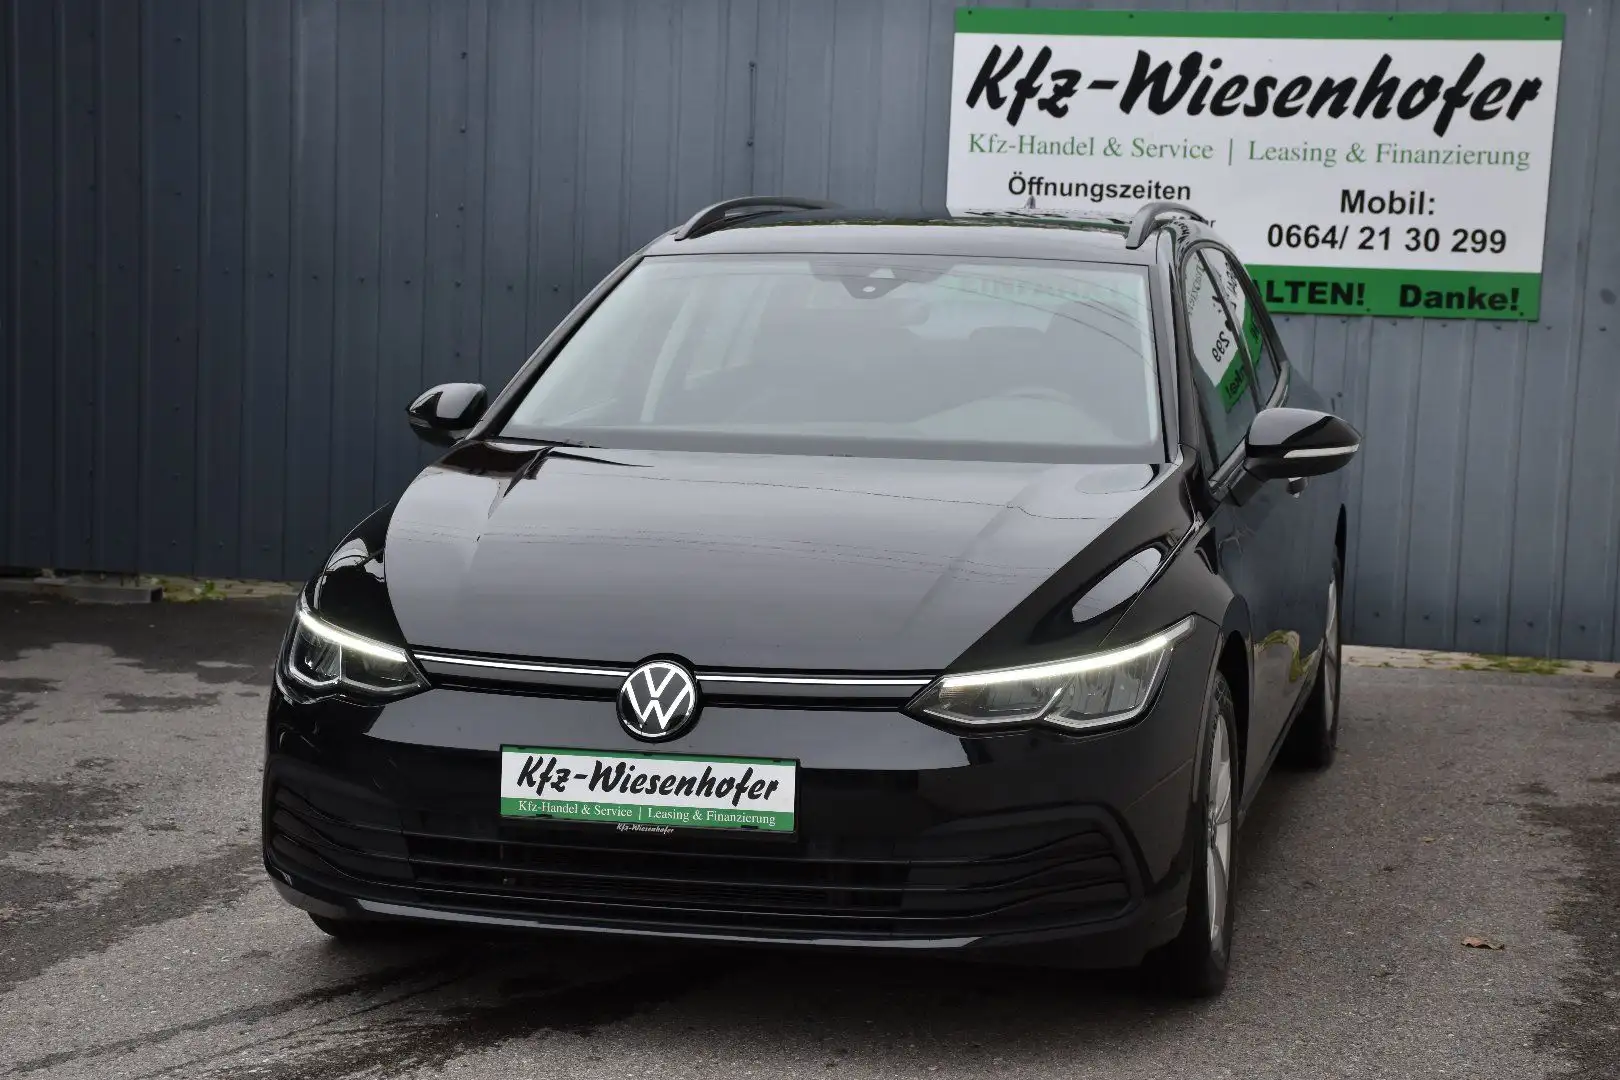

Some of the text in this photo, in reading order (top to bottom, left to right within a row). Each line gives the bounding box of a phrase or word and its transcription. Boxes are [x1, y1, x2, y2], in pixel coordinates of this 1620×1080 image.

[965, 44, 1543, 138] Kfz-Wiesenhofer
[968, 133, 1094, 156] Kfz-Handel
[1103, 137, 1122, 158] &
[1131, 137, 1214, 159] Service
[1248, 140, 1337, 168] Leasing
[1345, 142, 1366, 163] &
[1375, 143, 1531, 171] Finanzierung
[1008, 171, 1191, 202] Öffnungszeiten
[1340, 189, 1435, 216] Mobil:
[1267, 223, 1507, 253] 0664/ 21 30 299
[1399, 284, 1519, 311] Danke!
[517, 755, 779, 807] Kfz-Wiesenhofer
[518, 800, 578, 814] Kfz-Handel
[581, 805, 591, 815] &
[594, 805, 633, 818] Service
[648, 807, 690, 823] Leasing
[692, 810, 703, 821] &
[706, 810, 776, 827] Finanzierung
